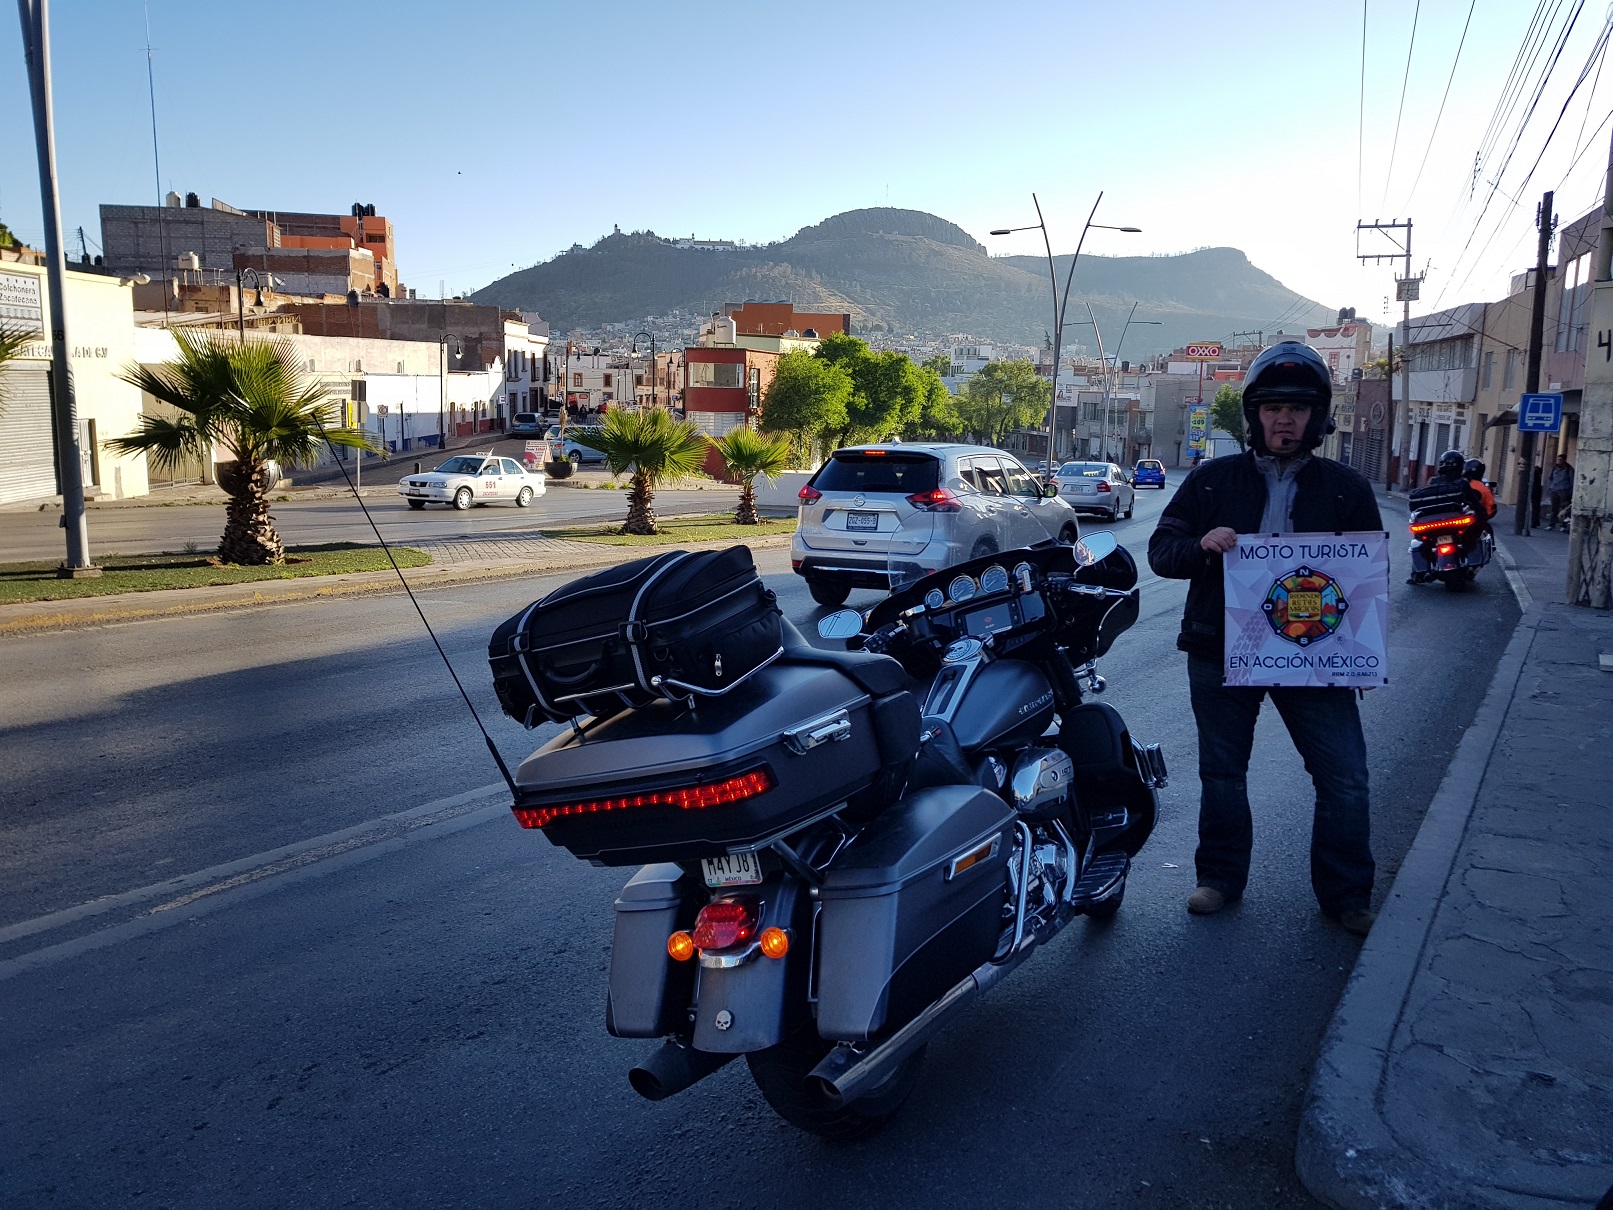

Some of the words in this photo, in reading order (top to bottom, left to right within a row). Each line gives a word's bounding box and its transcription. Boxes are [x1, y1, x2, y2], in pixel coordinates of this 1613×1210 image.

[1188, 346, 1219, 356] OXXO
[485, 481, 496, 489] 551
[1240, 545, 1294, 560] MOTO
[1299, 543, 1369, 559] TURISTA
[1229, 656, 1249, 669] EN
[1252, 651, 1315, 669] ACCIÓN
[1318, 652, 1379, 668] MÉXICO
